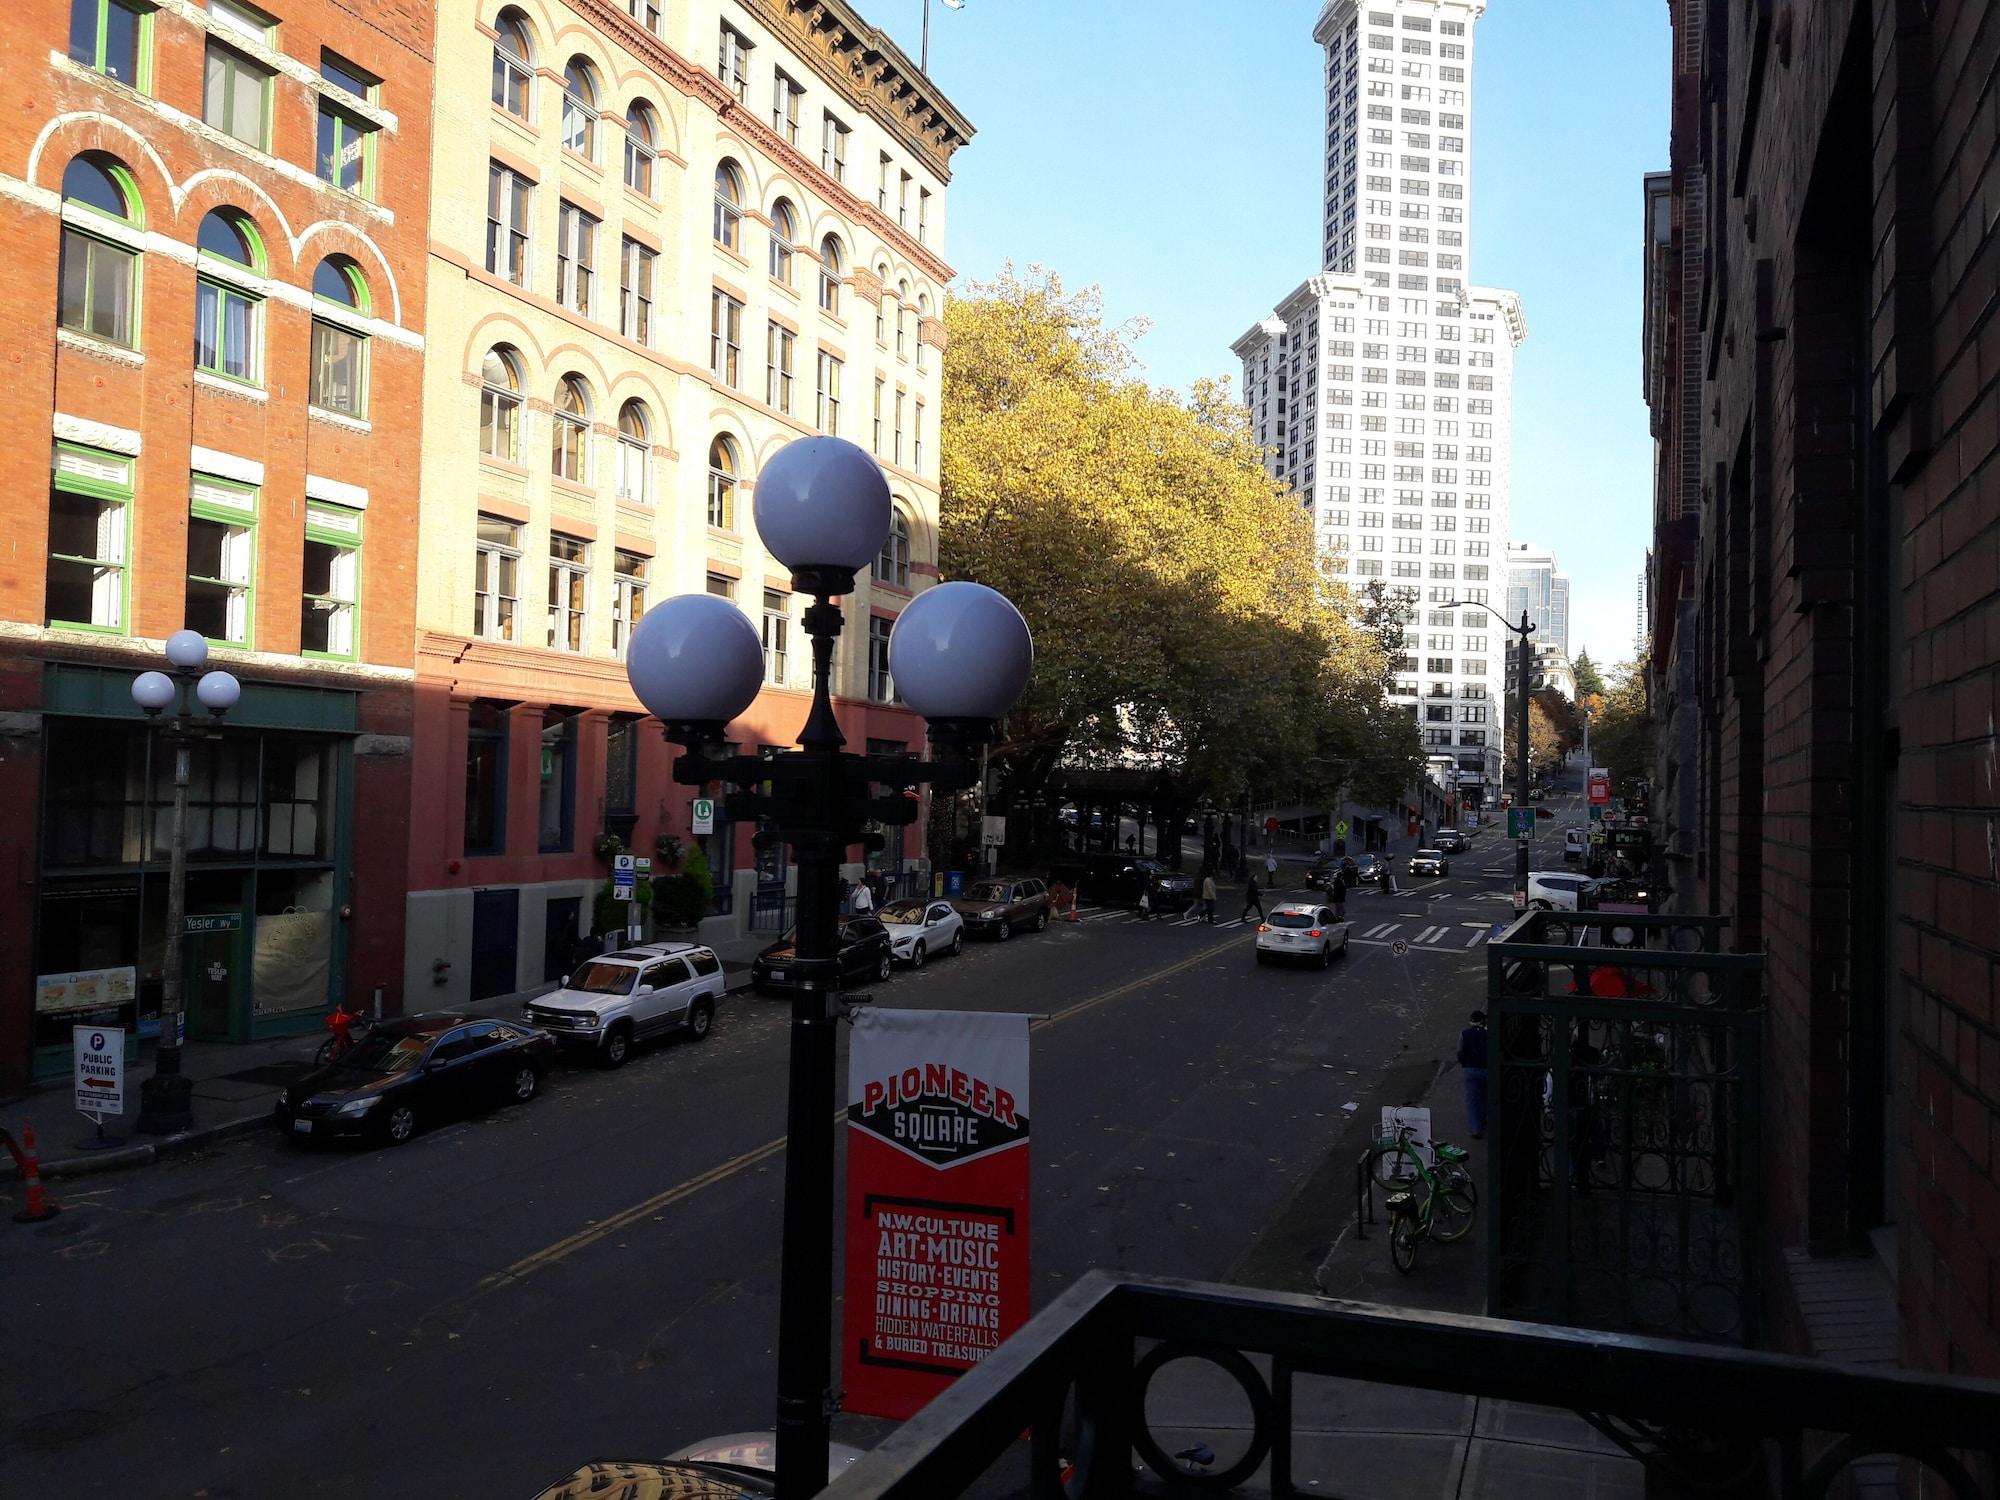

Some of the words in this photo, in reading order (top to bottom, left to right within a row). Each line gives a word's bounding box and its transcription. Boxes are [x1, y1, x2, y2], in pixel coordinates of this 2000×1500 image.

[187, 917, 215, 929] Yesler
[81, 1063, 116, 1077] PARKING
[83, 1052, 113, 1065] PUBLIC
[863, 1063, 1018, 1130] PIONEER
[894, 1111, 979, 1145] SQUARE
[876, 1280, 1000, 1306] SHOPPING
[875, 1316, 919, 1336] HIDDEN
[921, 1320, 999, 1348] WATERFALLS
[875, 1334, 883, 1349] &
[886, 1336, 928, 1354] BURIED
